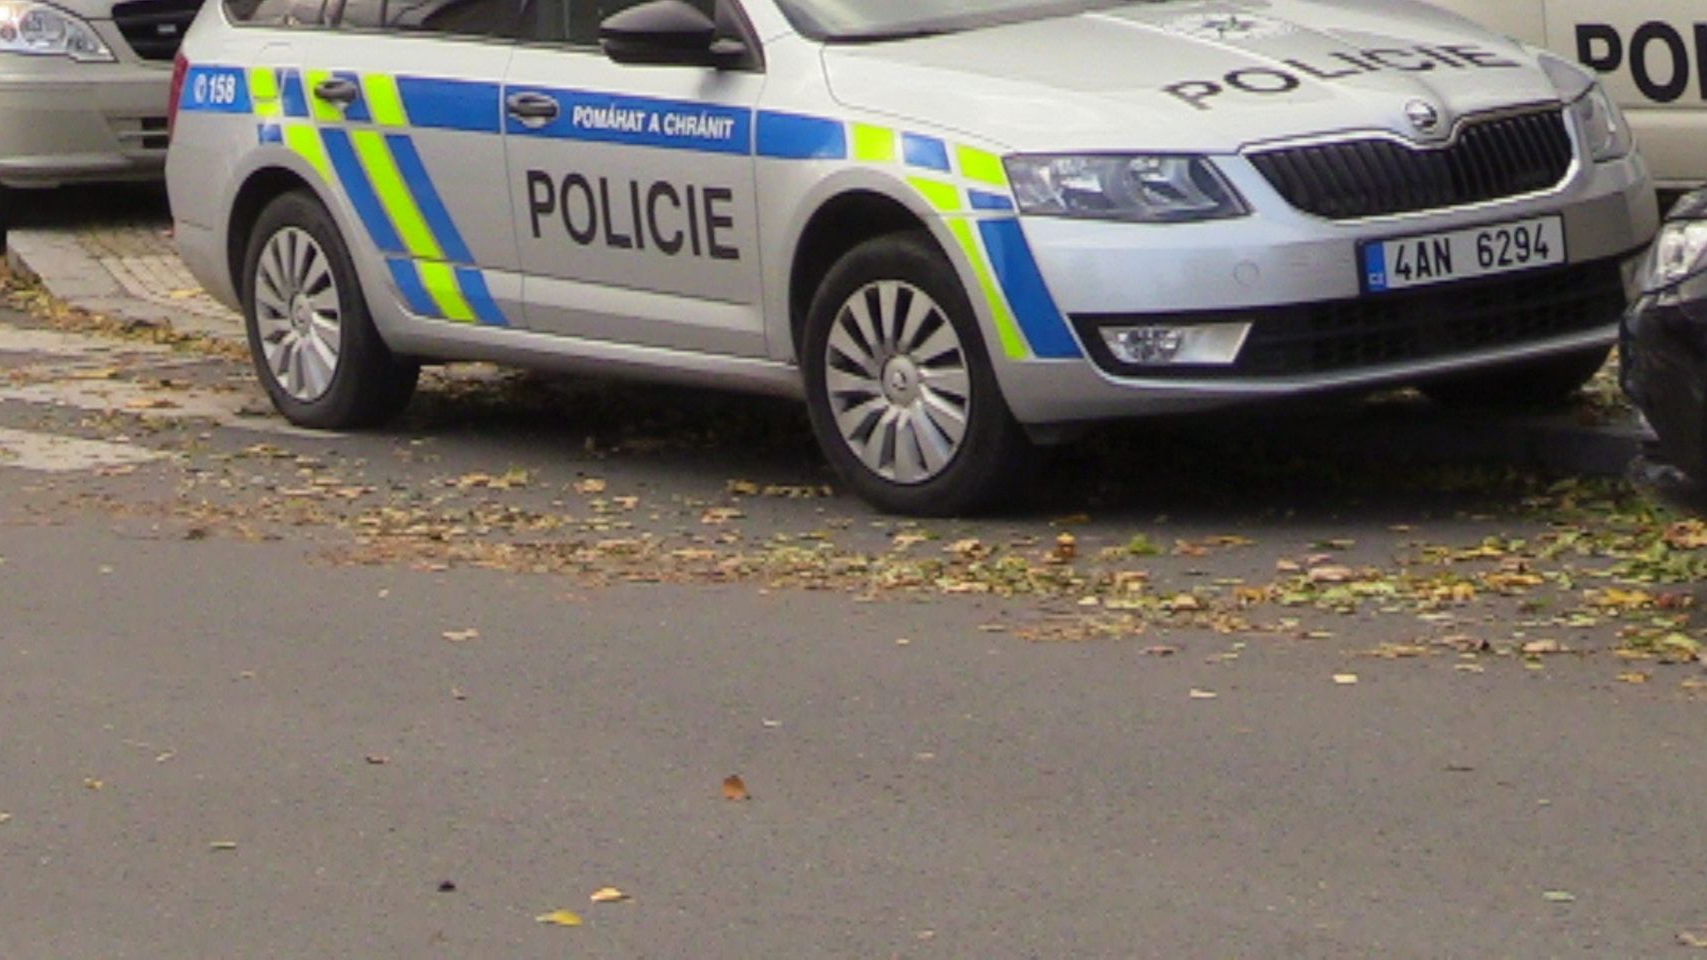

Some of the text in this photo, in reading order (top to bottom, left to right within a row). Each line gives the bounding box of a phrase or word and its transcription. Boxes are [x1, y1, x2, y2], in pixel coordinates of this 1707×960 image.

[209, 73, 236, 105] 158
[1162, 45, 1522, 111] POLICIE
[572, 103, 735, 140] POMÁHAT A CHRÁNIT
[525, 169, 740, 260] POLICIE
[1395, 238, 1454, 281] 4AN
[1476, 223, 1549, 270] 6294
